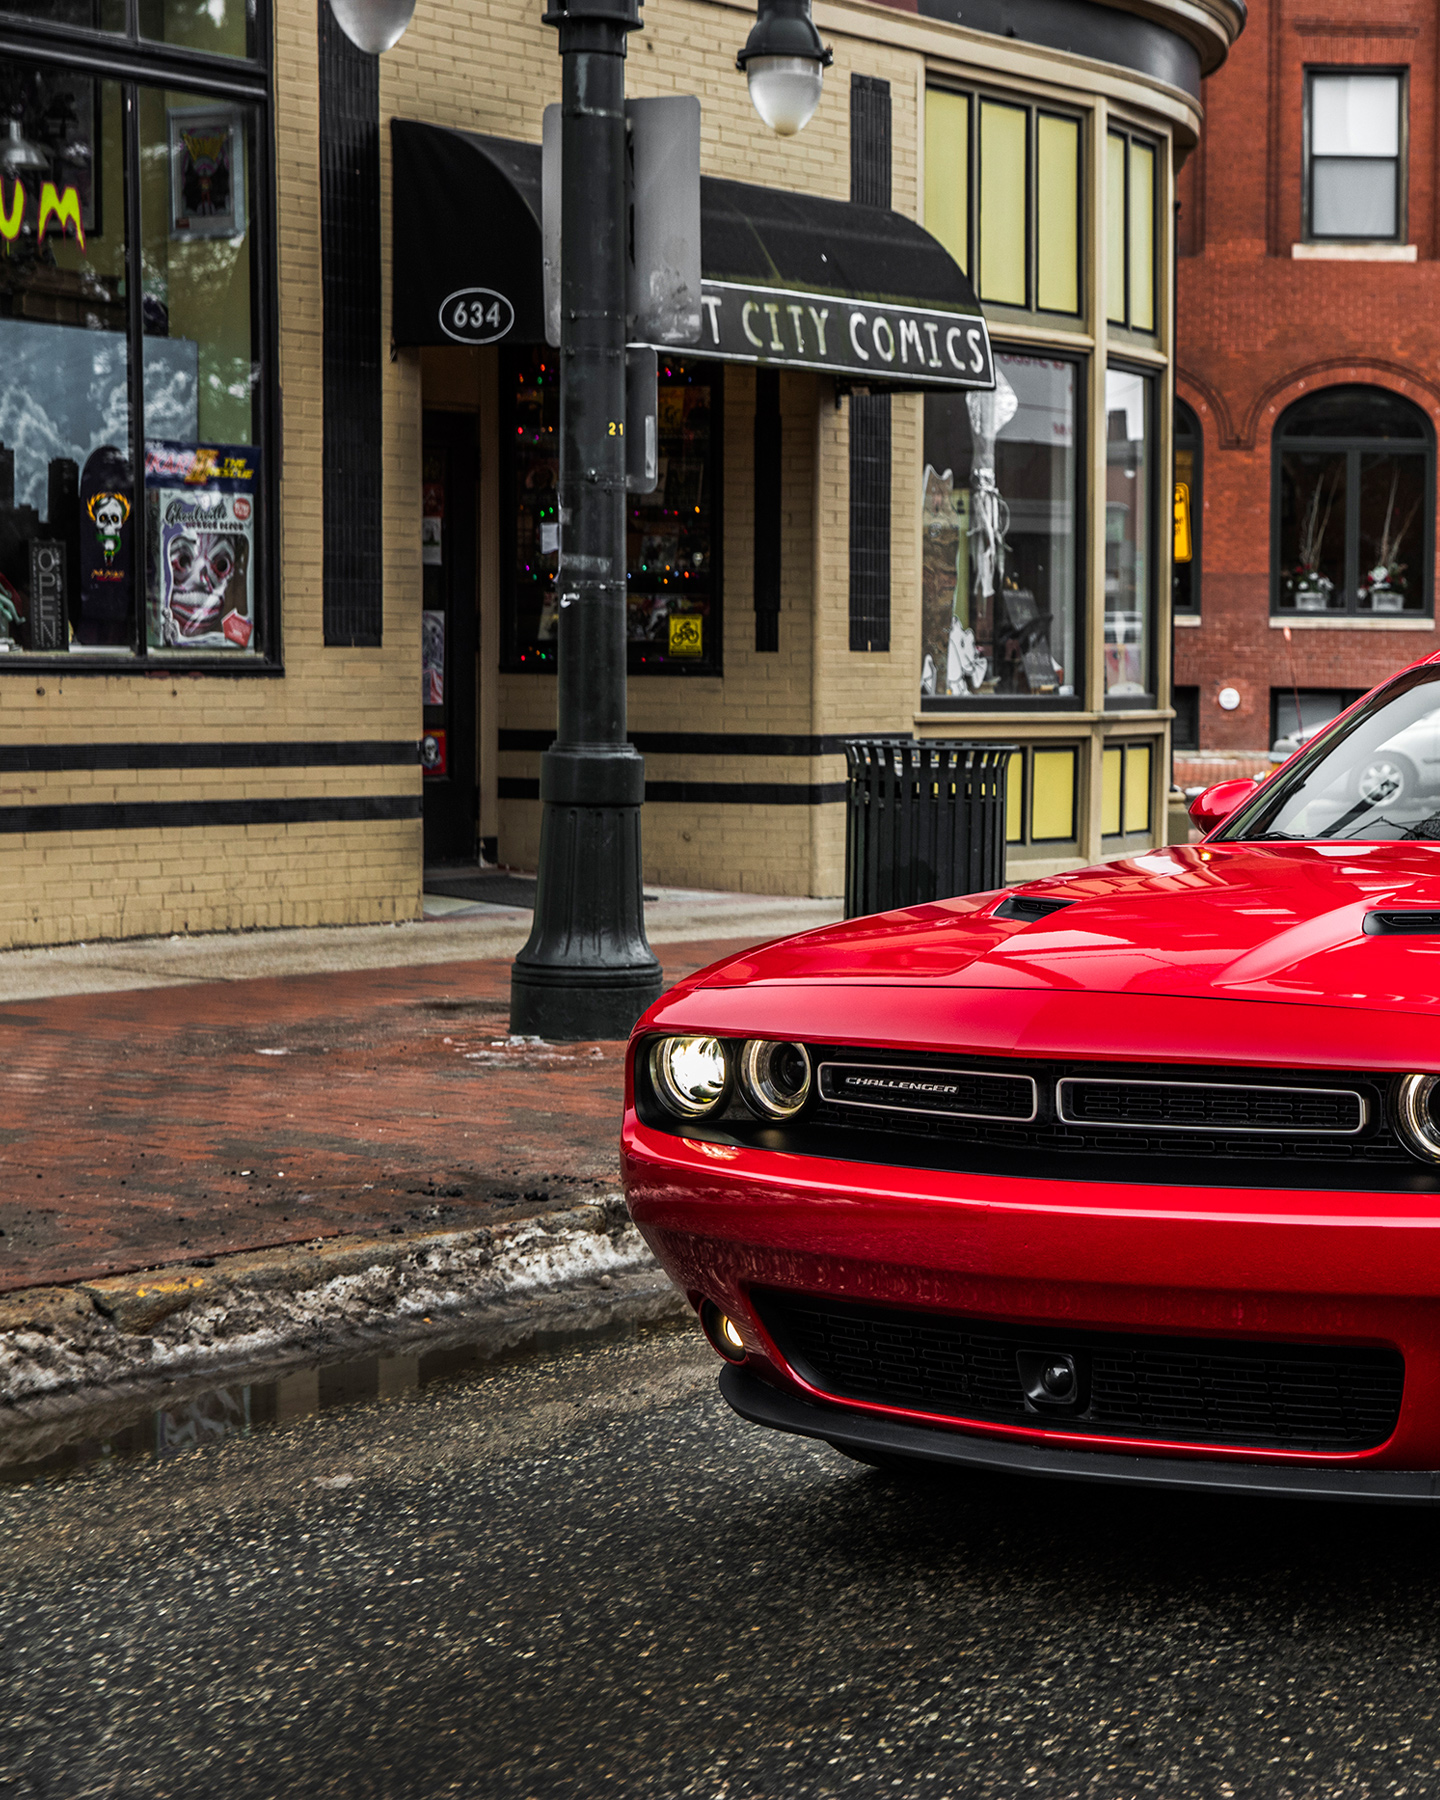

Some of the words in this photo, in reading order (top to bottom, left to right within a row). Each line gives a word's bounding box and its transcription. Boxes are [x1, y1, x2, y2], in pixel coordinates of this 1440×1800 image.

[453, 301, 500, 328] 634
[742, 301, 828, 355] CITY
[849, 312, 984, 373] COMICS
[608, 421, 624, 435] 21
[38, 549, 56, 647] OPEN
[845, 1077, 959, 1094] CHALLENGER
